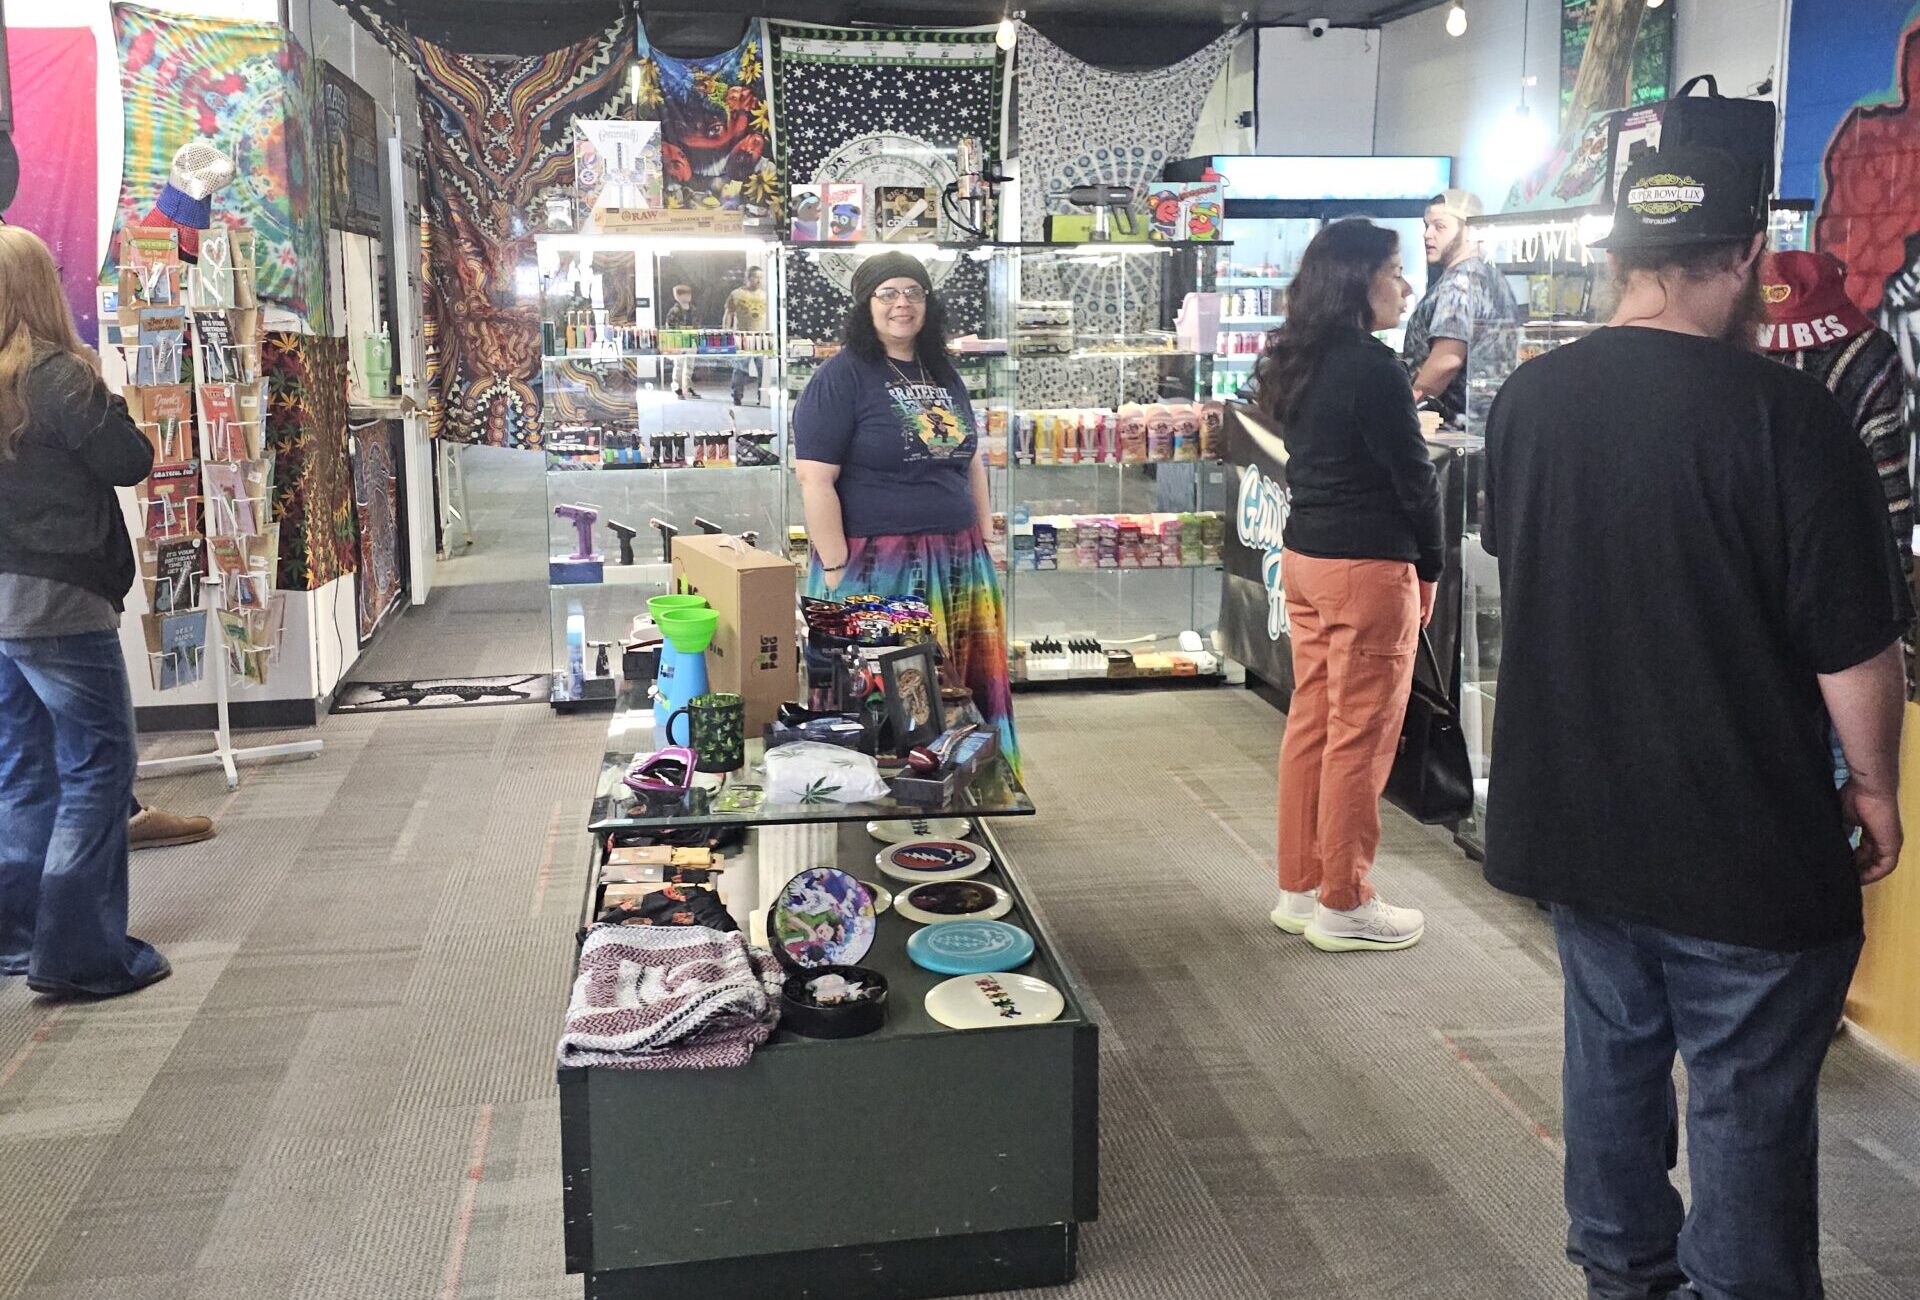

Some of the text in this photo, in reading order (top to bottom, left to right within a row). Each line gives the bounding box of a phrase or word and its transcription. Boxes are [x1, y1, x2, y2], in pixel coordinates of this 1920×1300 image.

[1631, 190, 1701, 201] SUPER BOWL LIX
[632, 210, 658, 221] RAW
[887, 219, 919, 227] COES
[1759, 315, 1848, 349] VIBES
[888, 385, 952, 400] GRATEFUL
